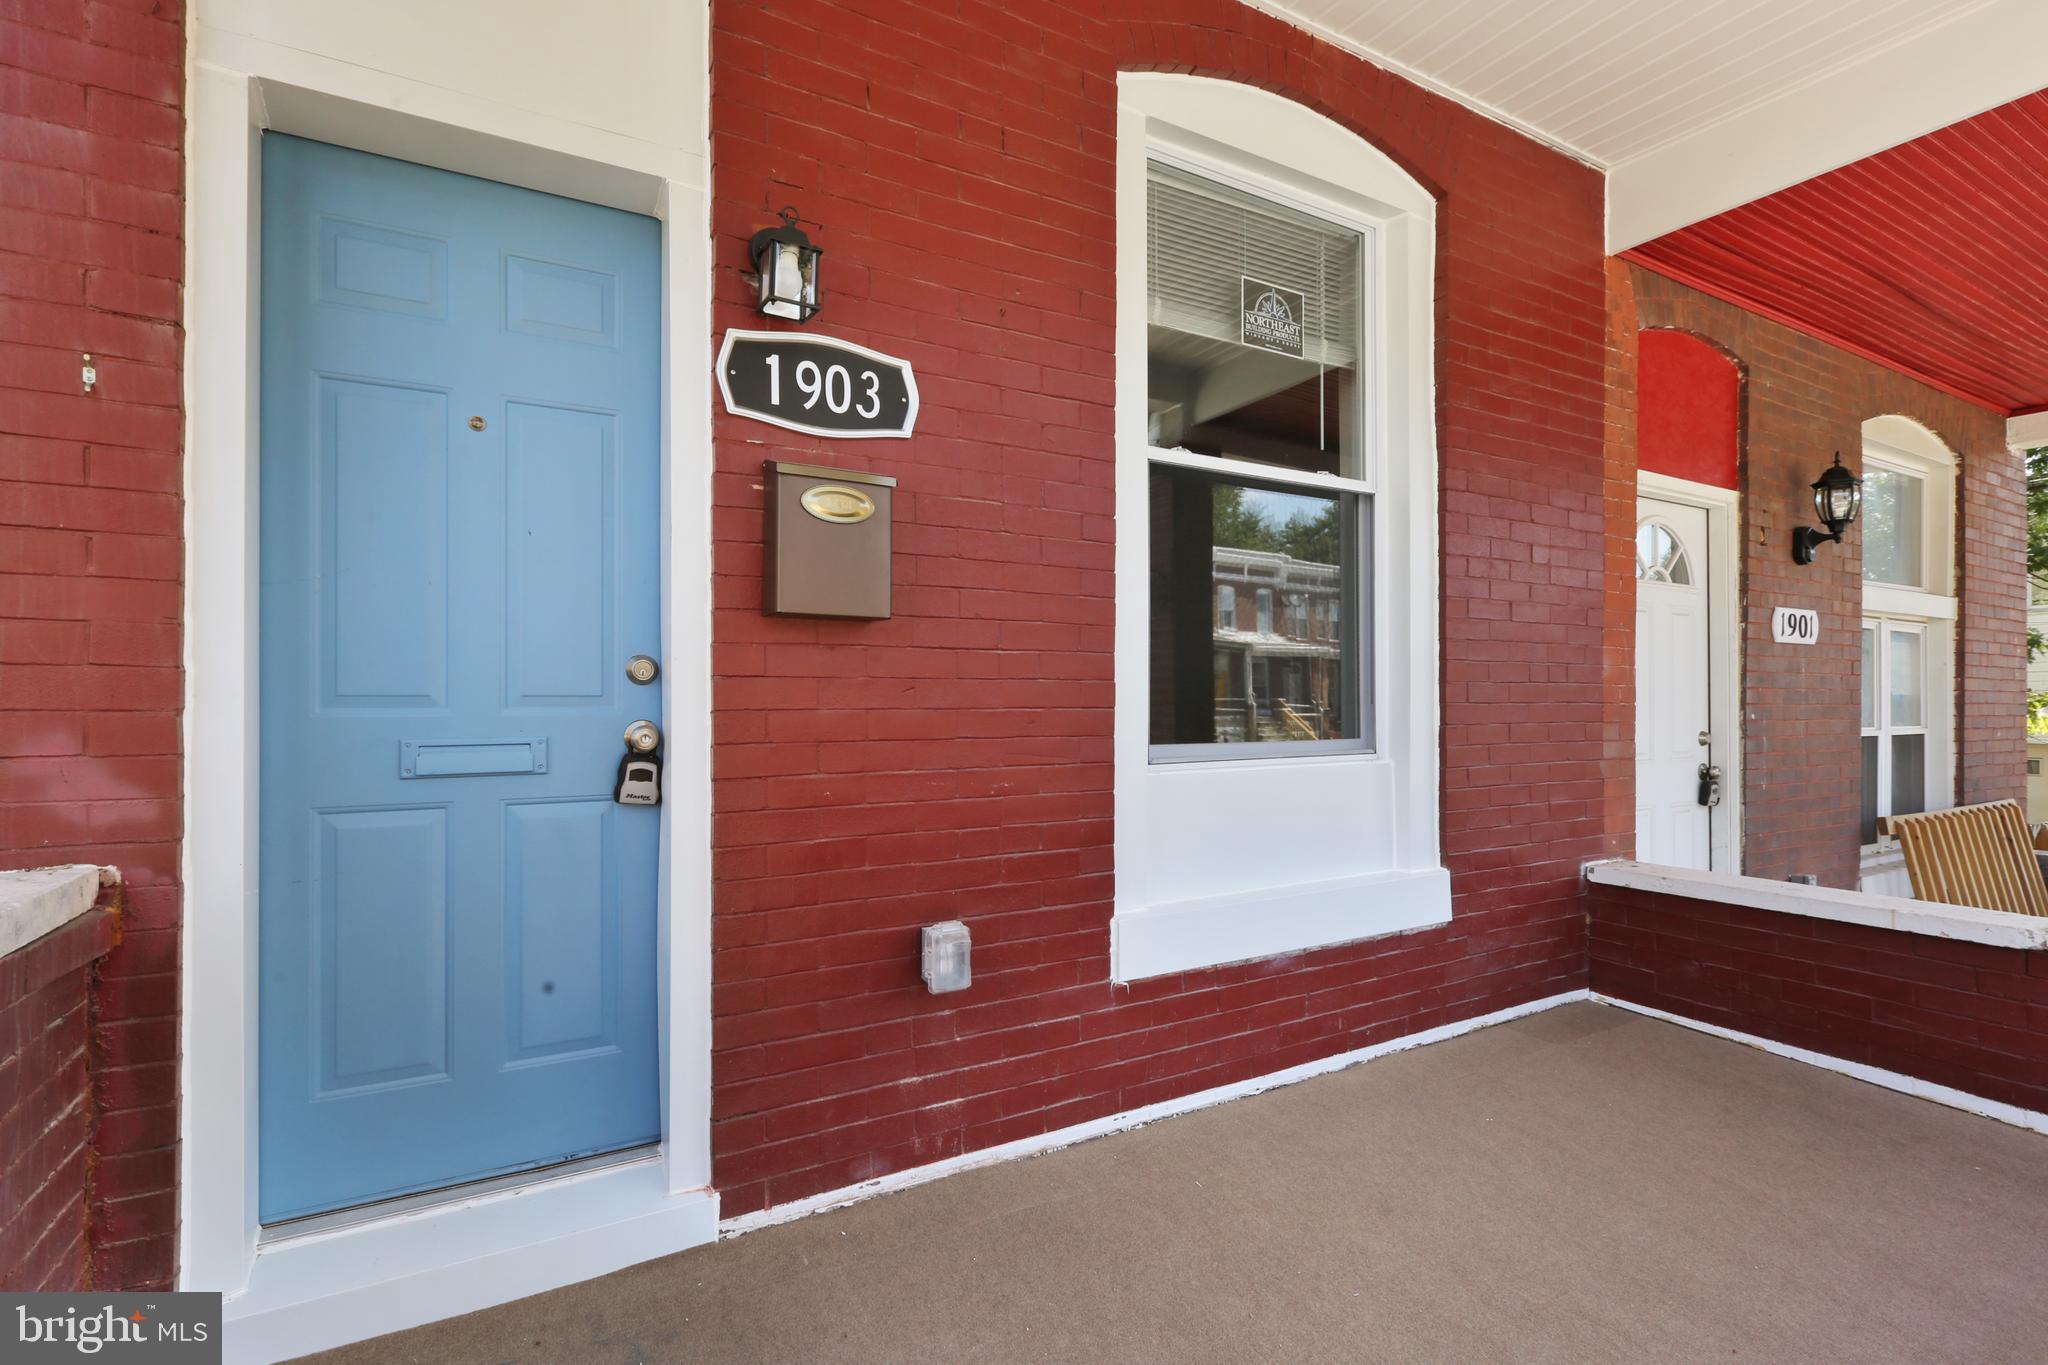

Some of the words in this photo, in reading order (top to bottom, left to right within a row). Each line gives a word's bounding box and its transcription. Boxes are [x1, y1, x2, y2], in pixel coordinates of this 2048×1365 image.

[1245, 312, 1301, 336] NORTHEAST
[1245, 323, 1272, 335] BUILDING
[1272, 330, 1300, 342] PRODUCTS
[765, 353, 881, 419] 1903
[1780, 612, 1813, 639] 1901
